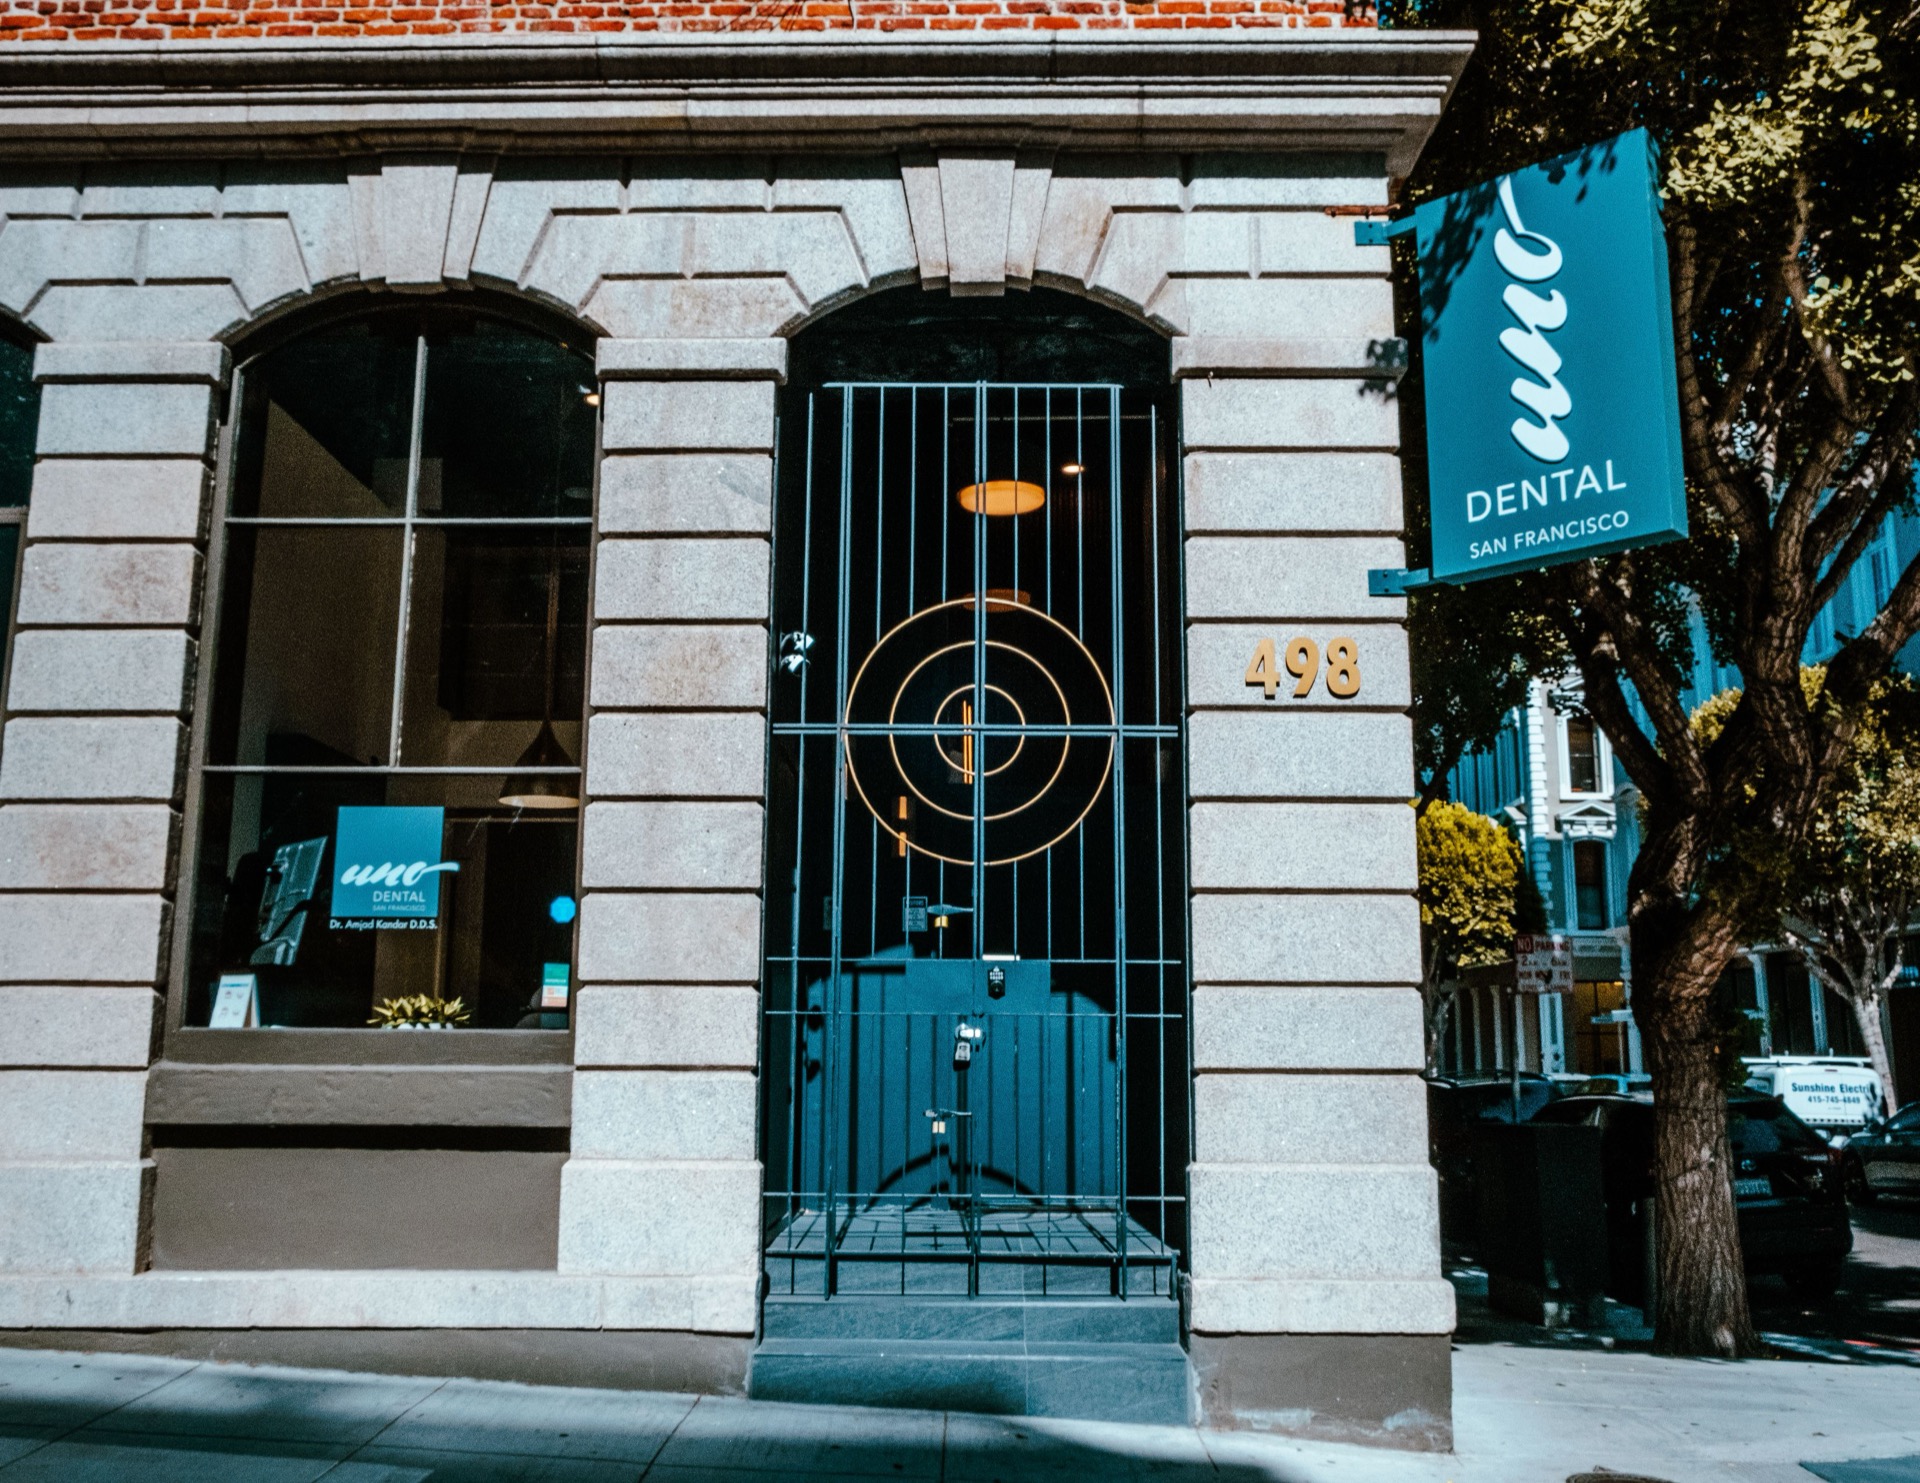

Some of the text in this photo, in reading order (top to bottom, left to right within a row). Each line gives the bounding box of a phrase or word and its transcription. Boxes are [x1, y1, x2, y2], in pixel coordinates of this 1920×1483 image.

[1494, 174, 1572, 462] uno
[1466, 459, 1627, 523] DENTAL
[1469, 510, 1630, 560] SAN FRANCISCO
[1245, 636, 1361, 700] 498
[340, 861, 460, 887] uno
[373, 890, 426, 902] DENTAL
[372, 904, 426, 912] SAN FRANCISCO
[329, 919, 344, 929] Dr.
[345, 919, 375, 932] Amjad
[409, 919, 438, 930] D.D.S.
[1517, 938, 1532, 952] NO
[1791, 1082, 1836, 1093] Sunshine
